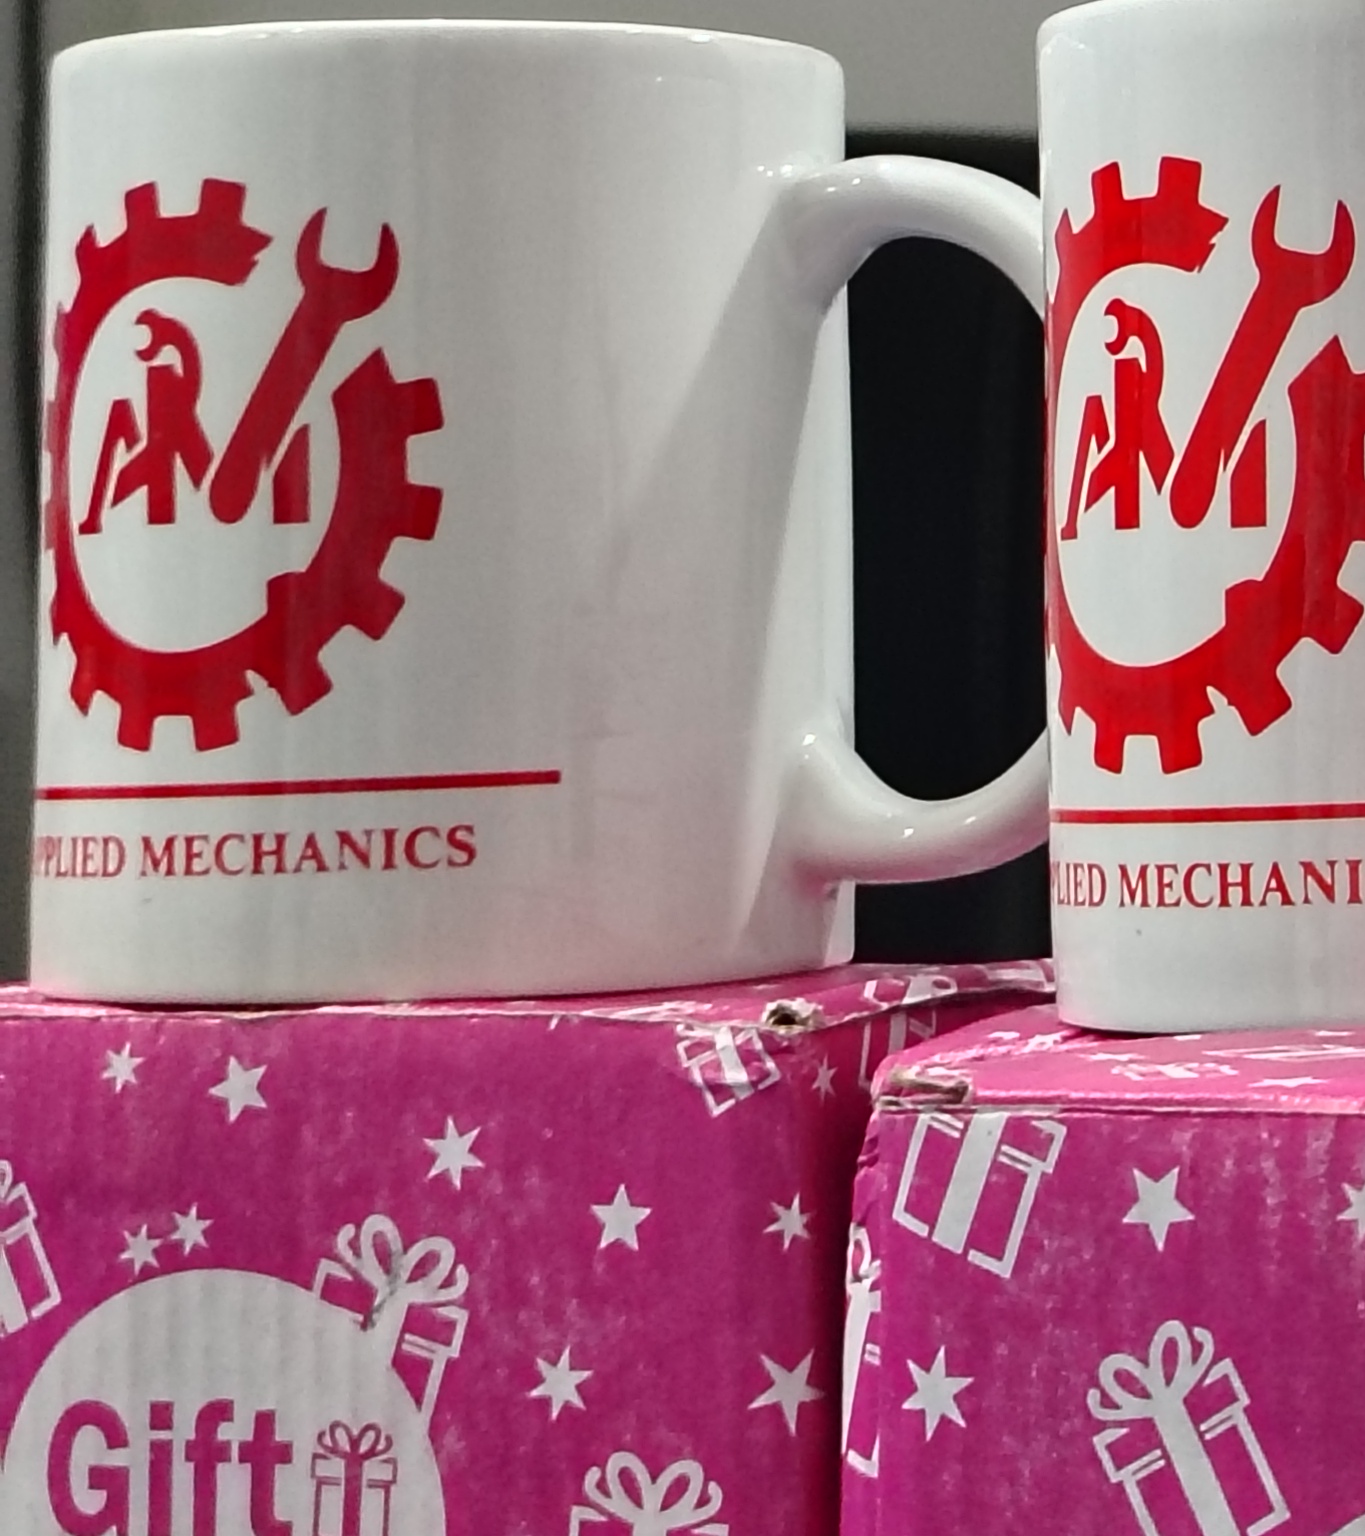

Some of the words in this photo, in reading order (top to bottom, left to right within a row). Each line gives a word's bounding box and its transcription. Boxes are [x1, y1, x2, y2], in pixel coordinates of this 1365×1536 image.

[37, 835, 126, 878] PLIED
[140, 824, 478, 878] MECHANICS
[47, 1399, 293, 1536] Gift
